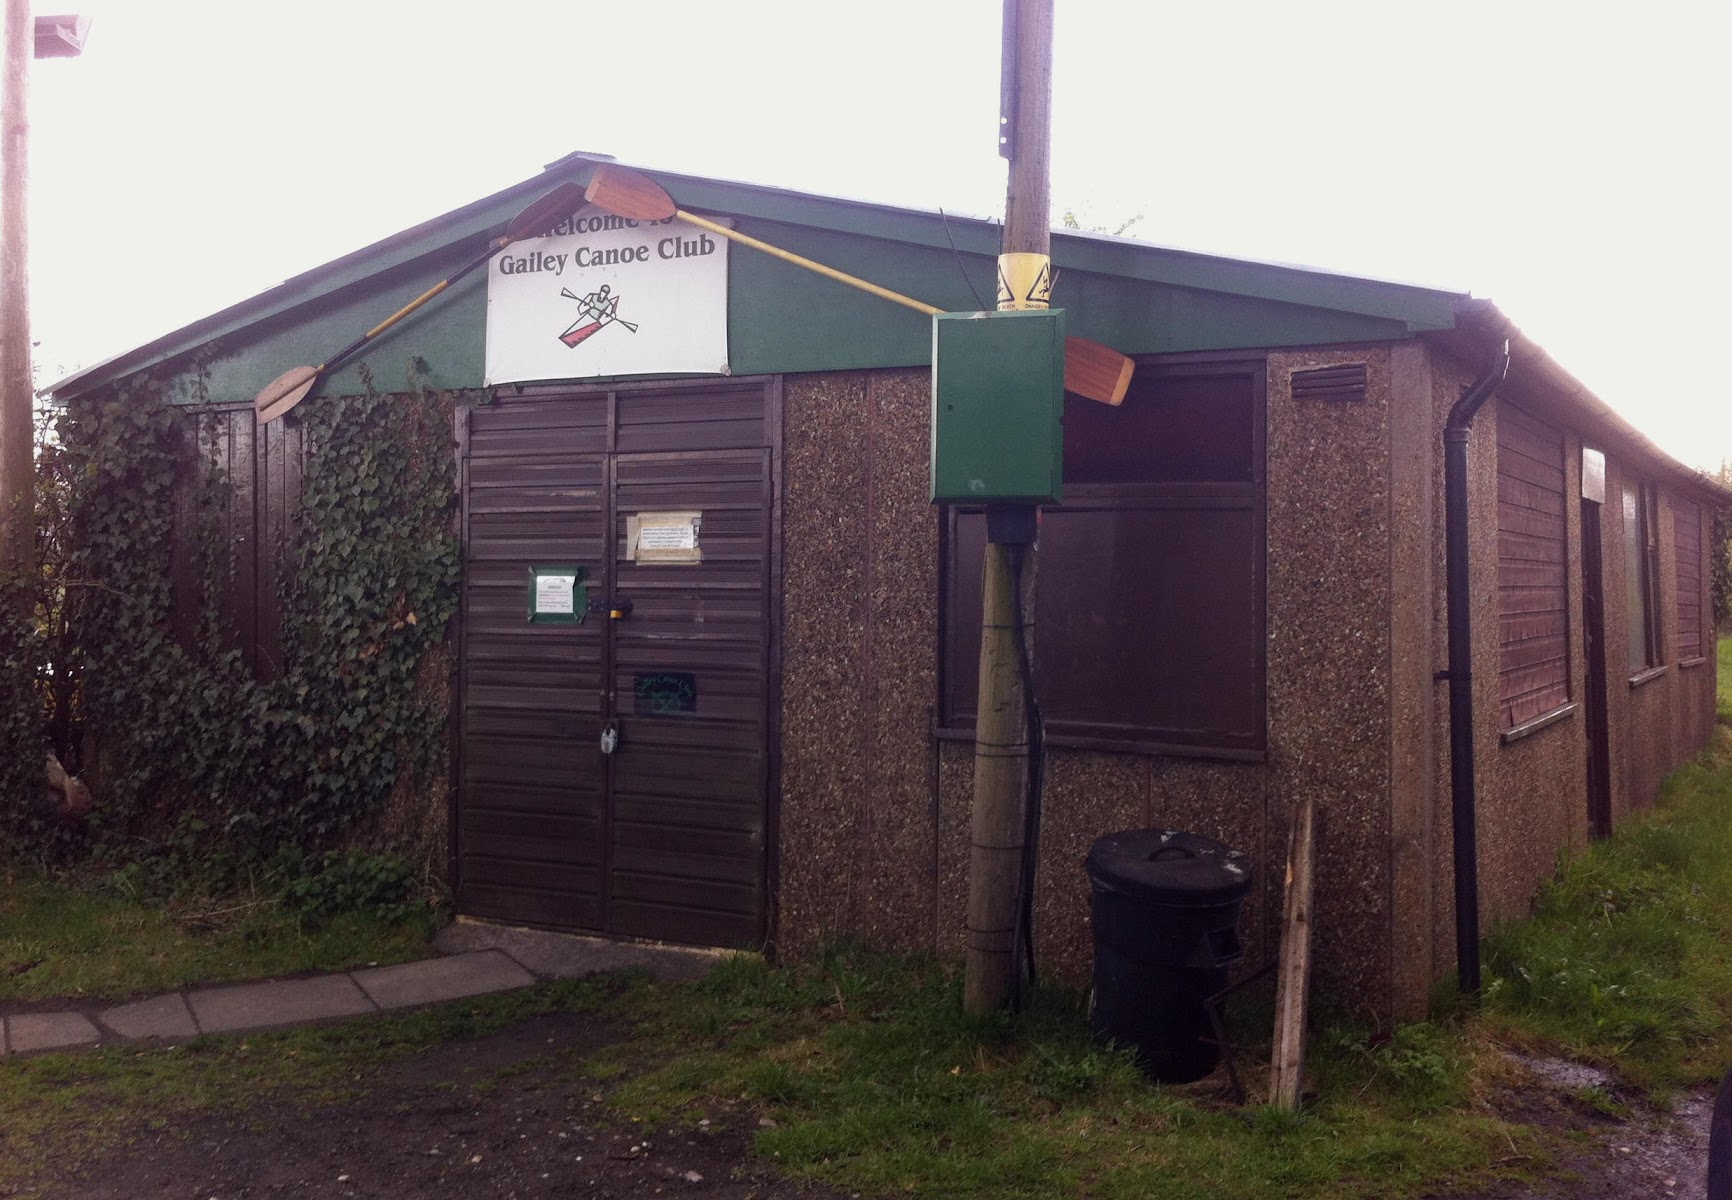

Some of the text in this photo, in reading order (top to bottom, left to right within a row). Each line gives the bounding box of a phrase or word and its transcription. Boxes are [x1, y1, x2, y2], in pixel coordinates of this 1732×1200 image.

[537, 214, 639, 238] elcome
[499, 234, 716, 276] Gailey Canoe Club
